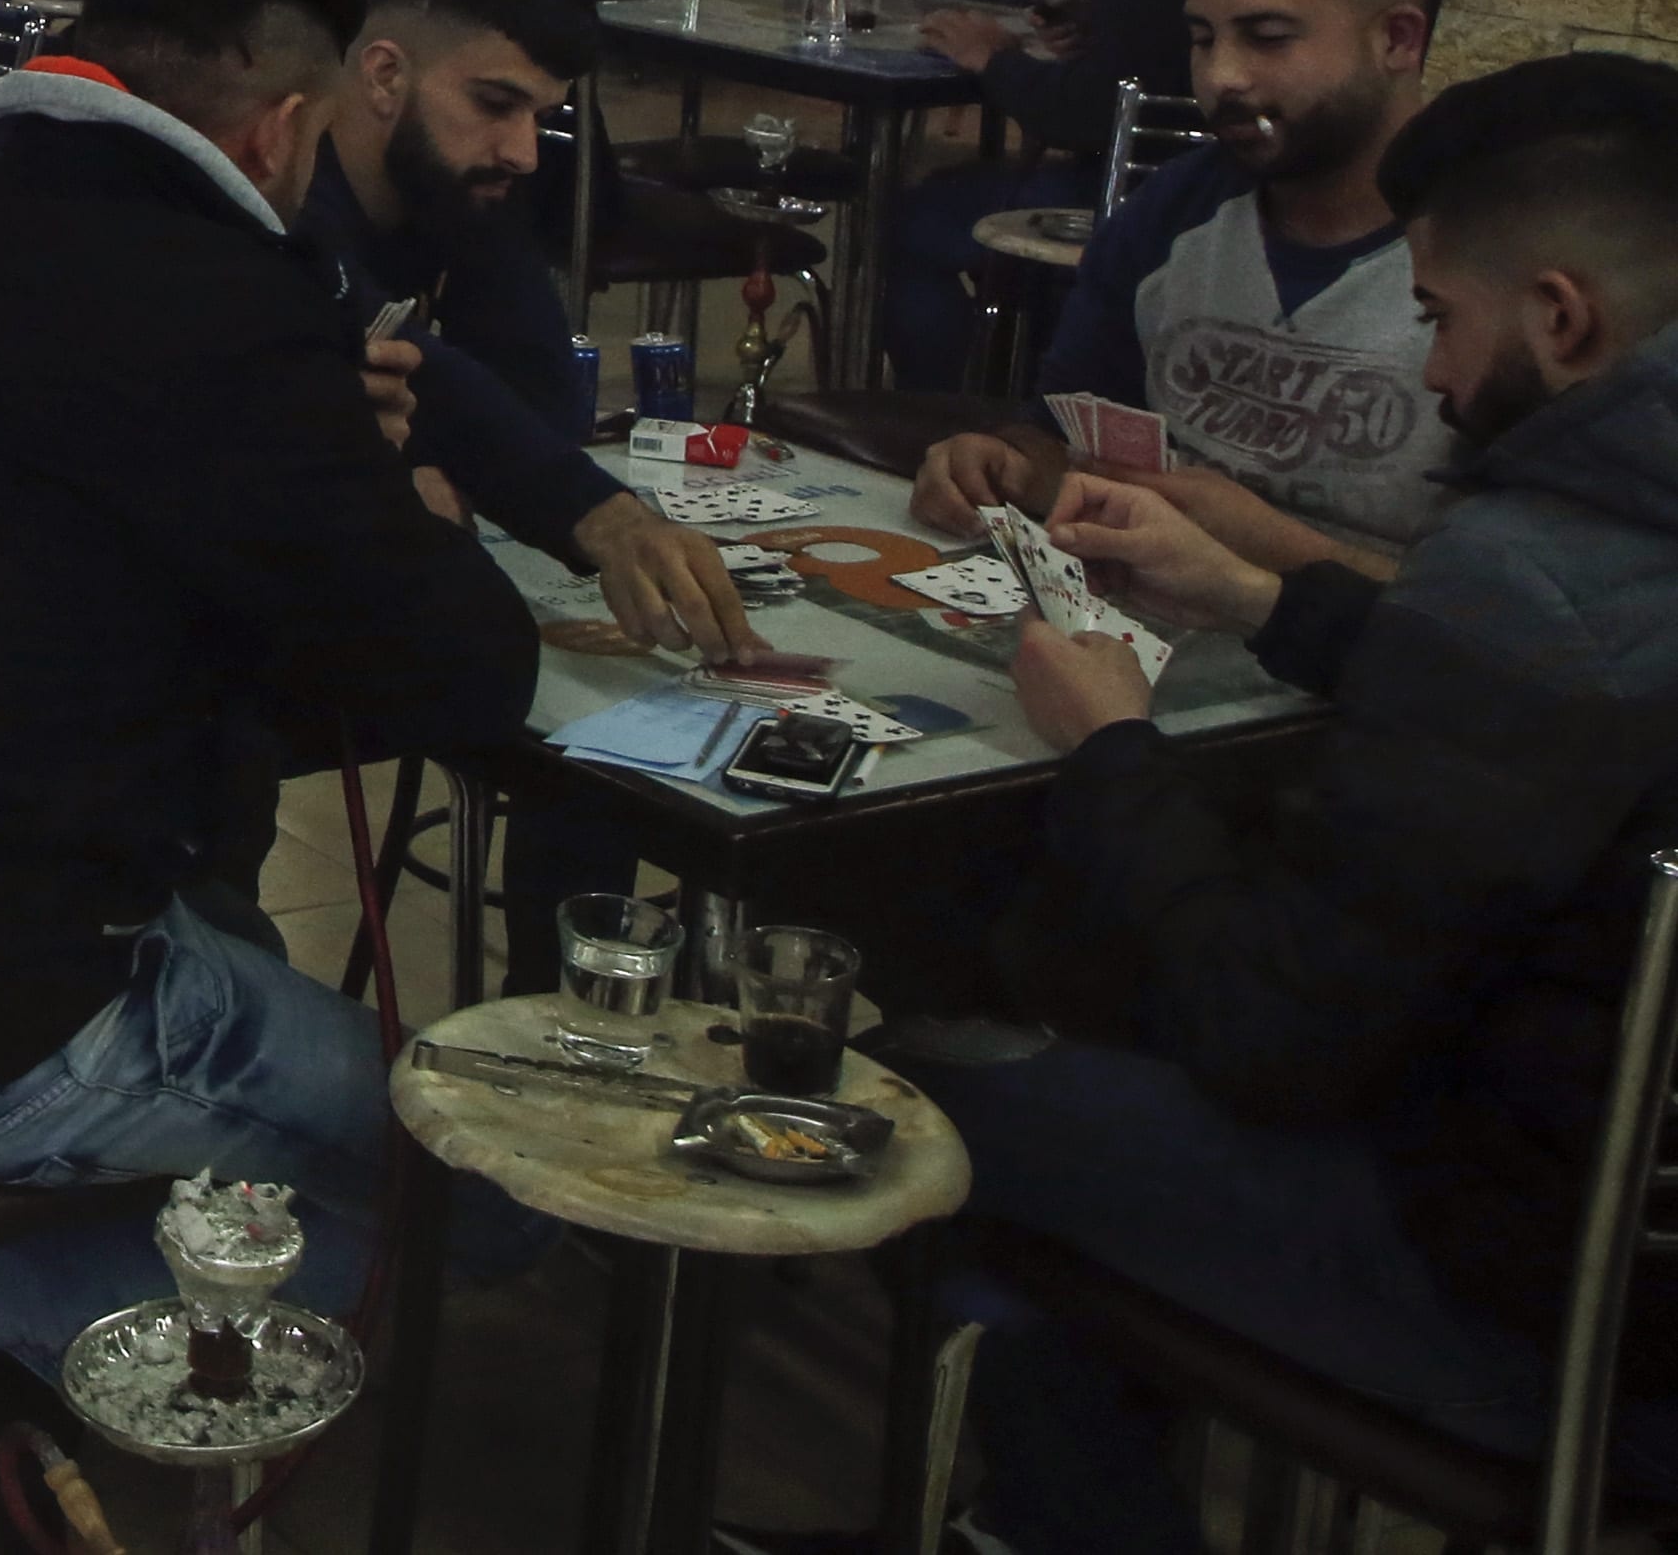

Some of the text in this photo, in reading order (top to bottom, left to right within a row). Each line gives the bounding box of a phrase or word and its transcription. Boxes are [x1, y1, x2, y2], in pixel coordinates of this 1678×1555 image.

[1172, 338, 1407, 451] START 50
[1184, 390, 1309, 457] TURBO
